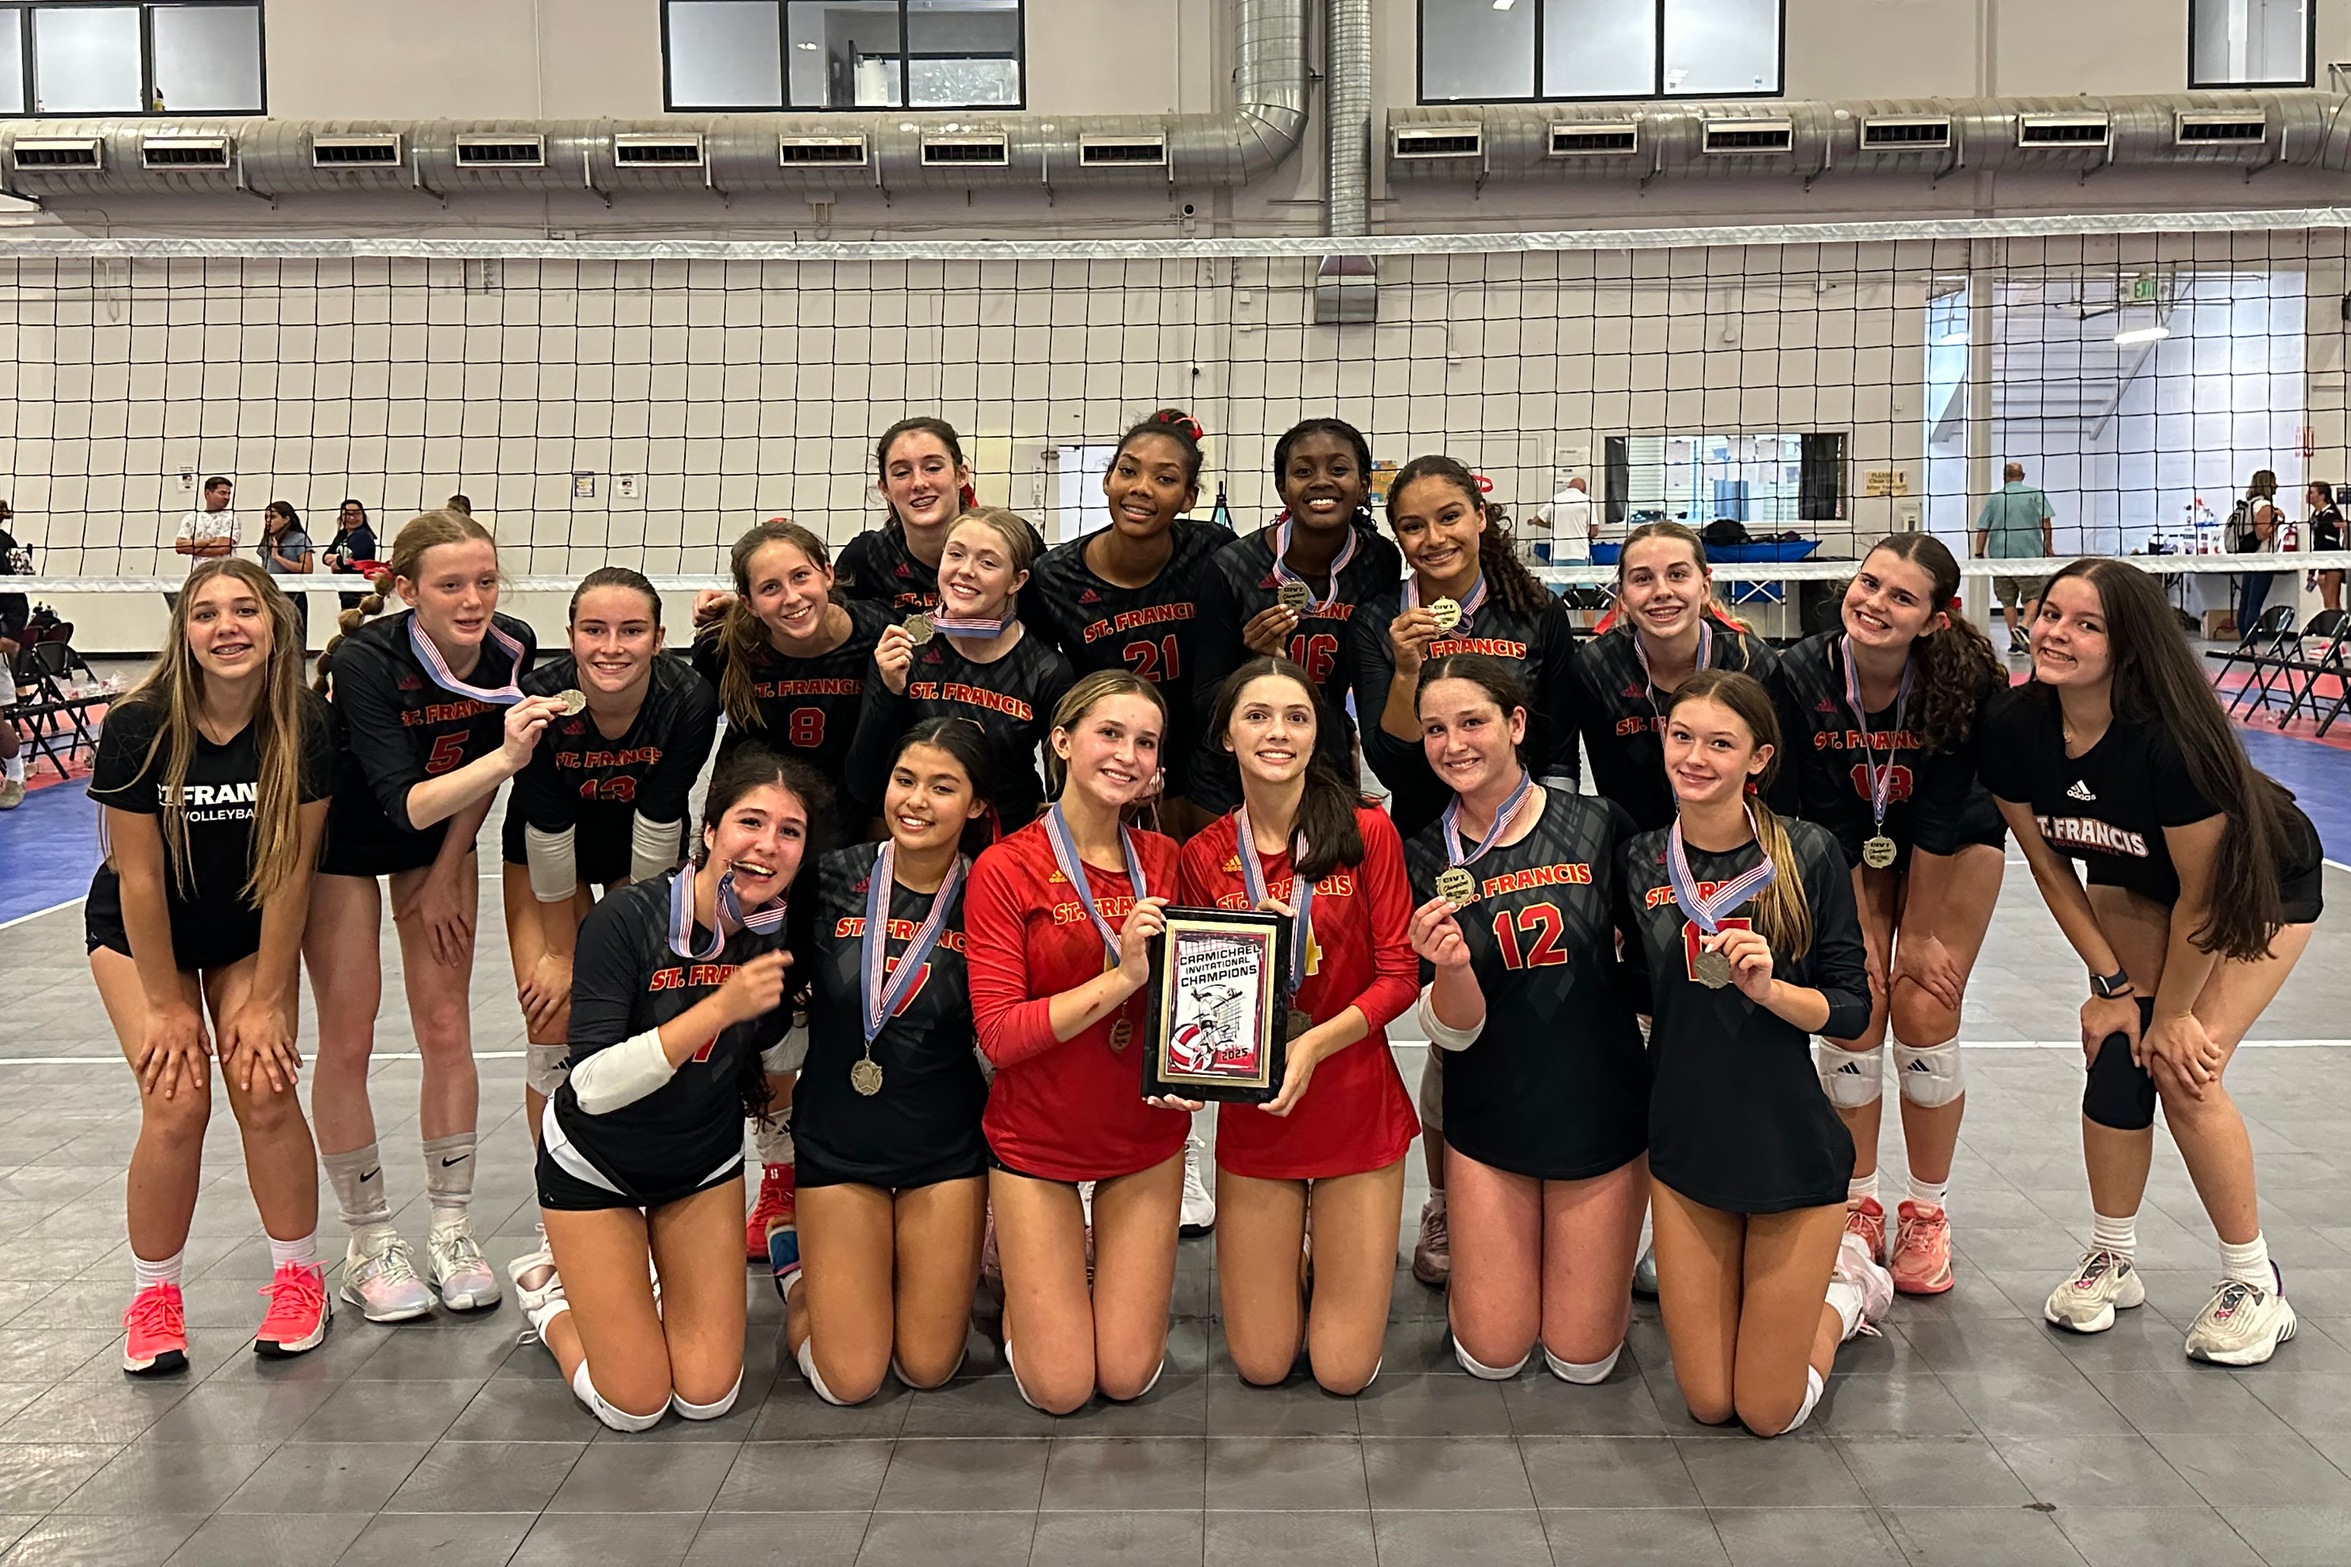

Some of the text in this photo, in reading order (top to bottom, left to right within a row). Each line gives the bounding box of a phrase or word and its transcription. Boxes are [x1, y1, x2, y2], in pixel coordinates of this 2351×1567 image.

[1083, 602, 1196, 644] ST. FRANCI
[1123, 634, 1180, 682] 21
[1290, 633, 1339, 684] 16
[1429, 638, 1527, 660] FRANCIS
[910, 681, 1033, 721] ST. FRANCIS
[789, 707, 826, 748] 8
[1616, 716, 1648, 736] ST.
[425, 730, 470, 774] 5
[1814, 731, 1843, 751] ST.
[2052, 817, 2149, 857] FRANCIS
[1443, 874, 1465, 884] CIVT
[1482, 863, 1592, 899] FRANCIS
[1053, 902, 1087, 925] ST.
[1492, 901, 1568, 971] 12
[1180, 943, 1261, 966] CARMICHAEL
[1186, 957, 1250, 974] INVITATIONAL
[649, 967, 685, 991] ST.
[1181, 964, 1257, 987] CHAMPIONS
[1222, 1047, 1249, 1061] 2025
